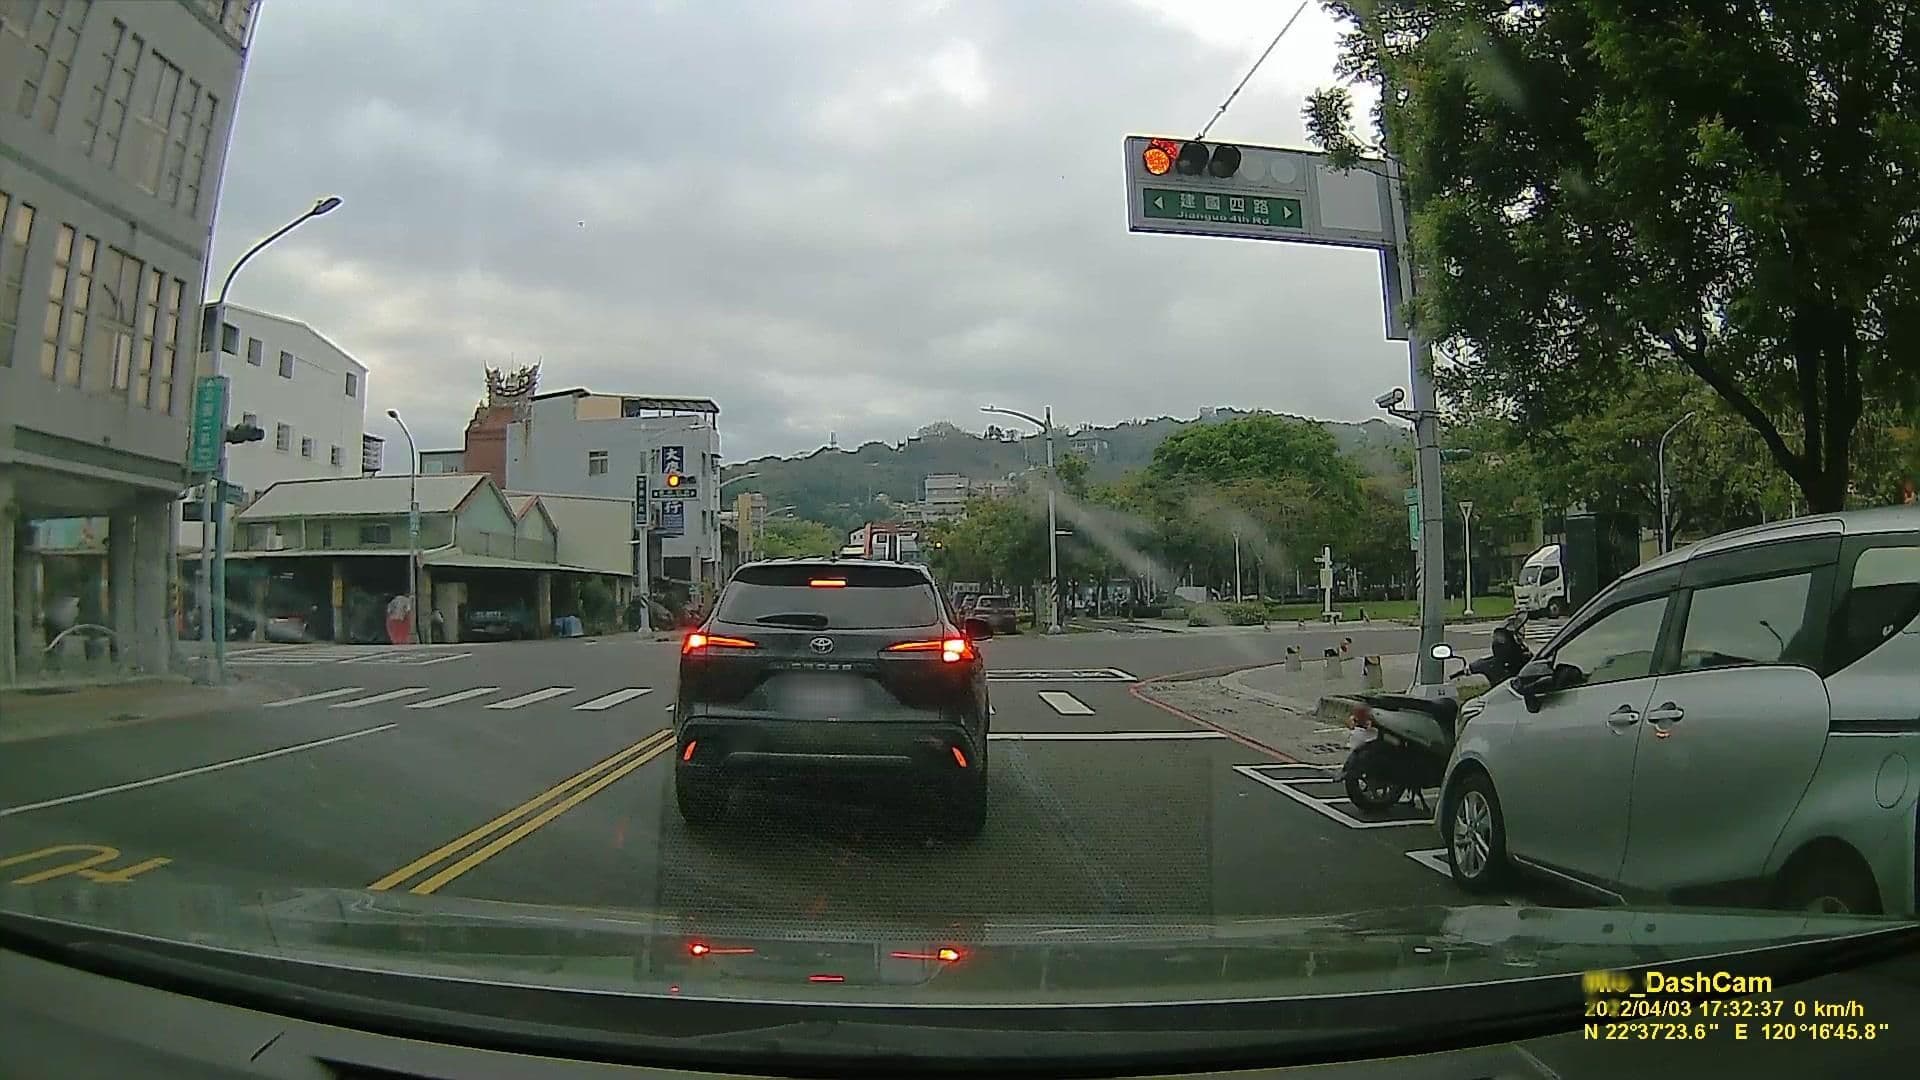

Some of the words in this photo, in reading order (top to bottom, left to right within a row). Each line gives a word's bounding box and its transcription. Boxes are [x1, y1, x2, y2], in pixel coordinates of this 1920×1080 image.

[1180, 192, 1269, 215] 建國四路
[1177, 210, 1227, 222] Jianguo
[1228, 214, 1249, 225] 4th
